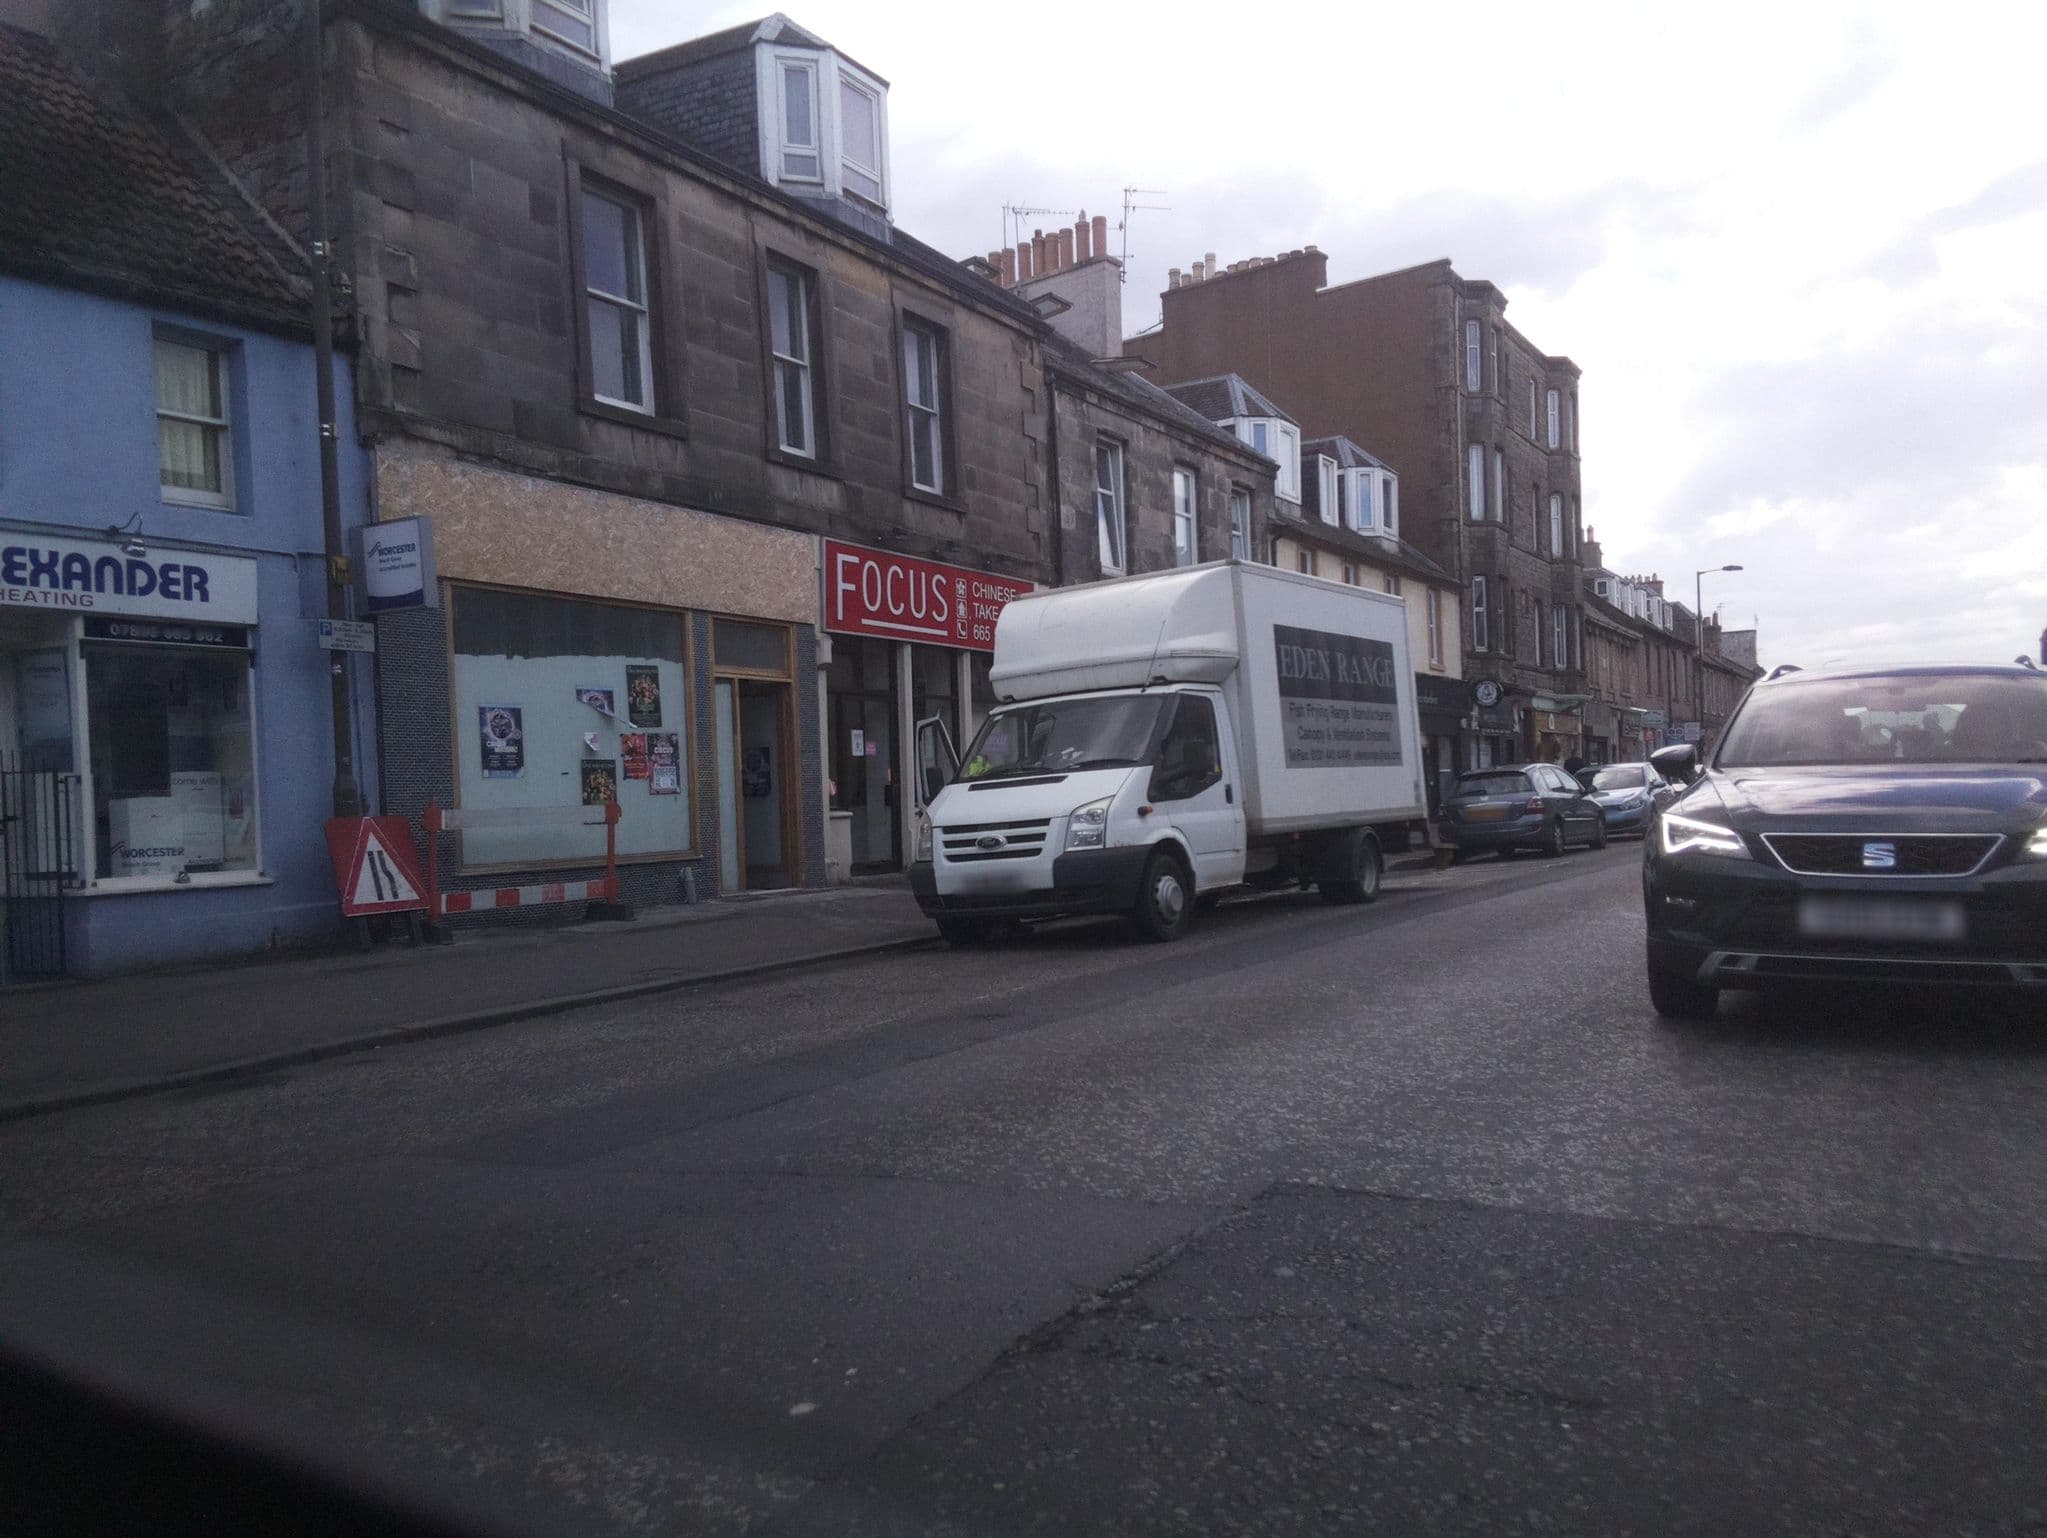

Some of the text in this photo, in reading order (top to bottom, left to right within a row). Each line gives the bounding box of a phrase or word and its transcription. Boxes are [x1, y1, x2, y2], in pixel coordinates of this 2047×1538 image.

[378, 543, 417, 557] WORCESTER
[836, 553, 949, 623] FOCUS
[972, 582, 1016, 603] CHINESE
[973, 624, 991, 641] 665
[1279, 644, 1393, 687] EDEN RANGE
[120, 847, 185, 858] WORCESTER
